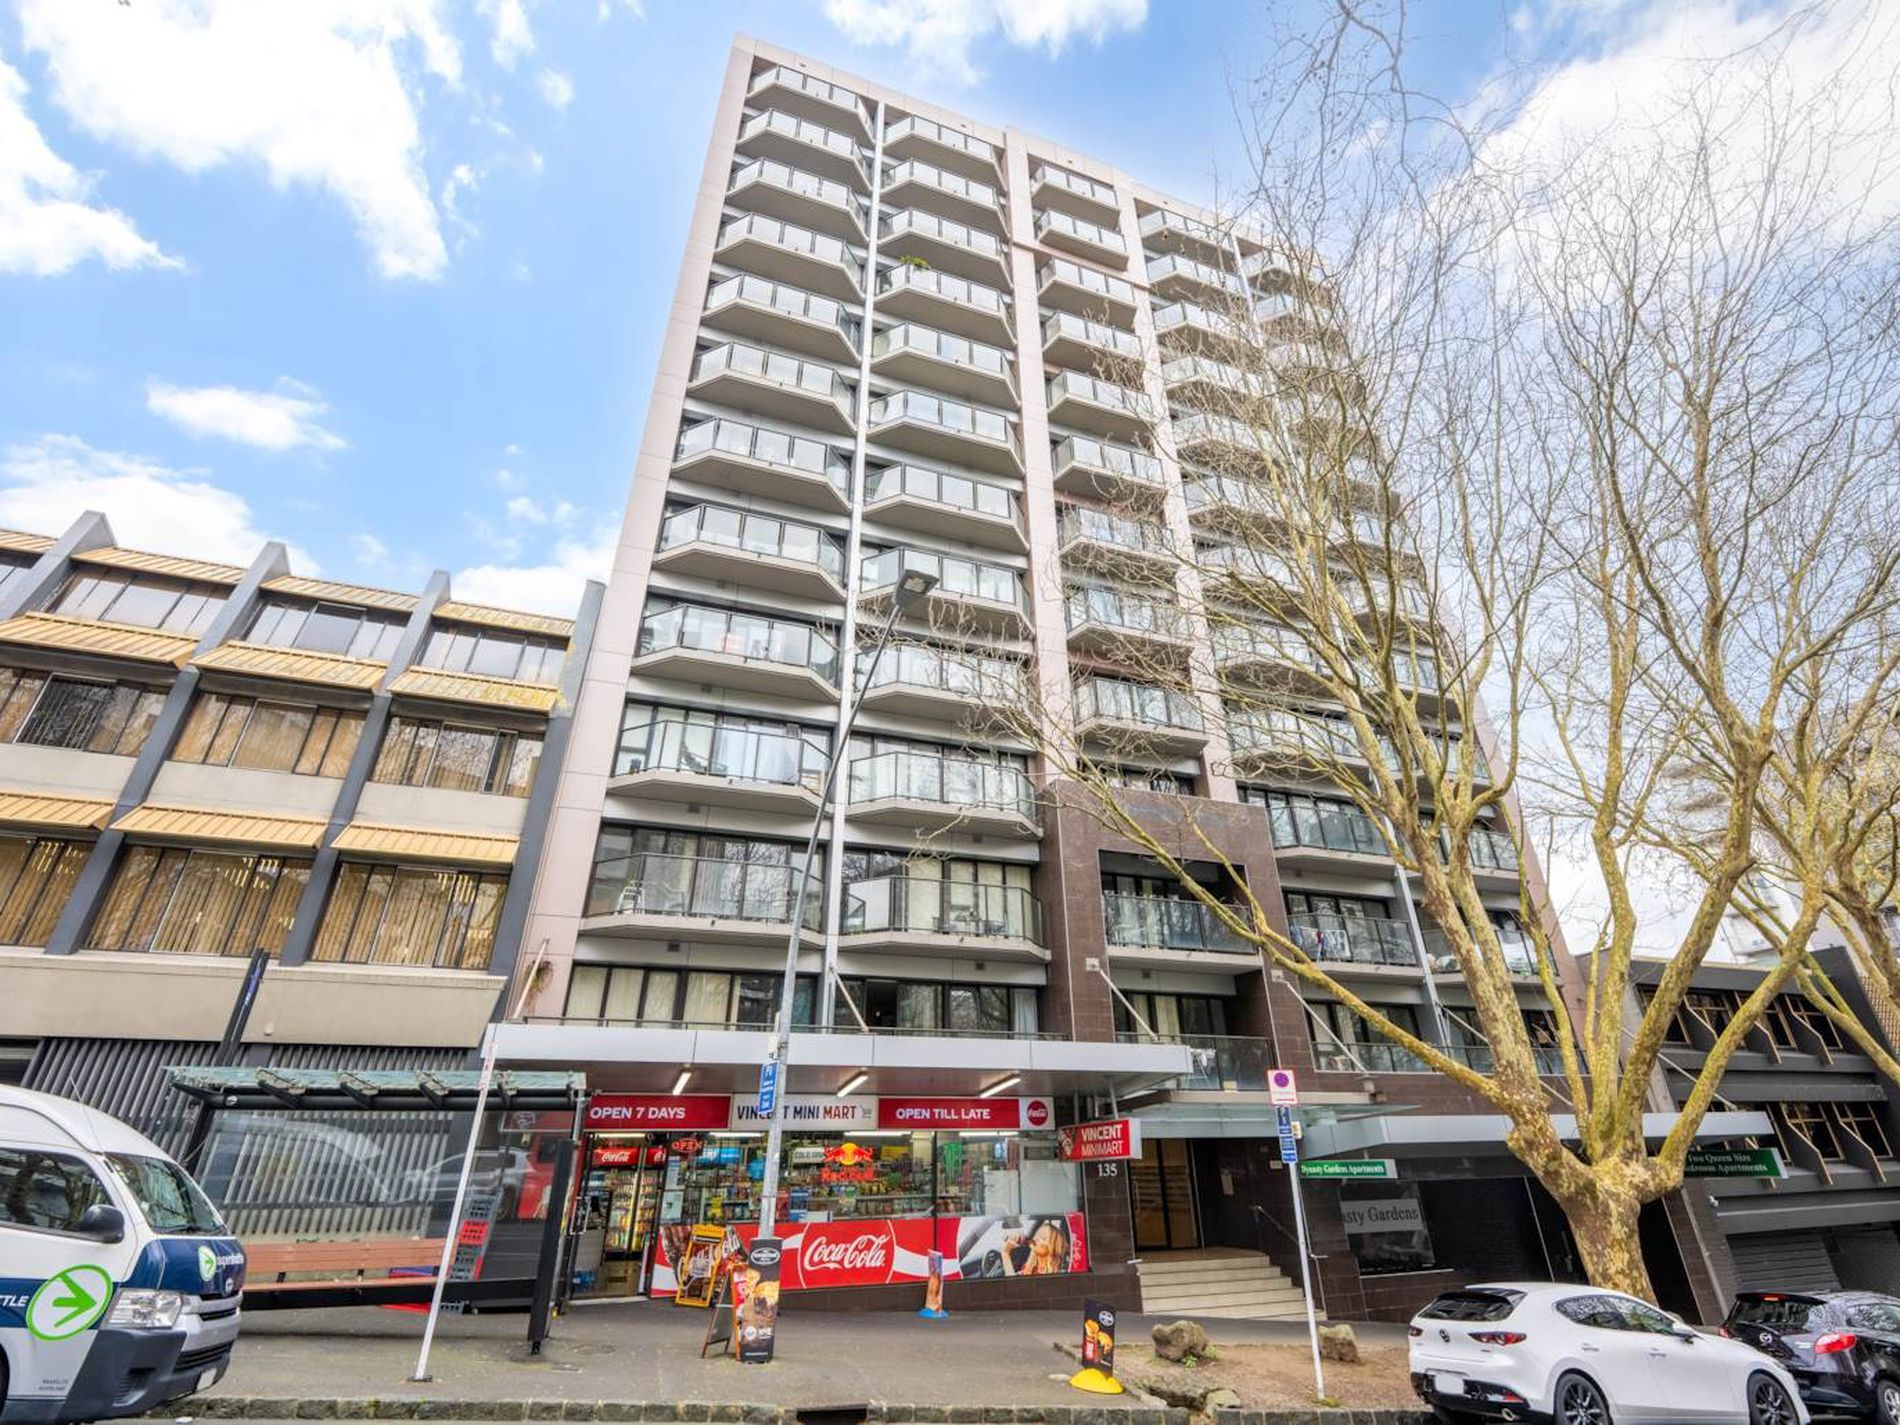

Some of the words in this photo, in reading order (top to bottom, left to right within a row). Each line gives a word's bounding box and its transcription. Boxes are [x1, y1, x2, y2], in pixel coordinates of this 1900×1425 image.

[590, 1106, 632, 1119] OPEN
[636, 1107, 646, 1119] 7
[649, 1107, 686, 1119] DAYS
[737, 1105, 789, 1120] VINT
[793, 1106, 820, 1119] MINI
[823, 1105, 857, 1120] MART
[896, 1108, 930, 1120] OPEN
[933, 1108, 958, 1120] TILL
[961, 1108, 991, 1120] LATE
[1081, 1124, 1123, 1142] VINCENT
[1081, 1140, 1124, 1157] MINIMART
[1705, 1153, 1732, 1164] Queen
[1097, 1163, 1118, 1177] 135
[1323, 1164, 1347, 1174] Gardens
[1348, 1164, 1384, 1177] Apartments
[1718, 1163, 1768, 1174] Apartments
[1367, 1206, 1418, 1221] Gardens
[803, 1234, 891, 1270] Coca-Cola
